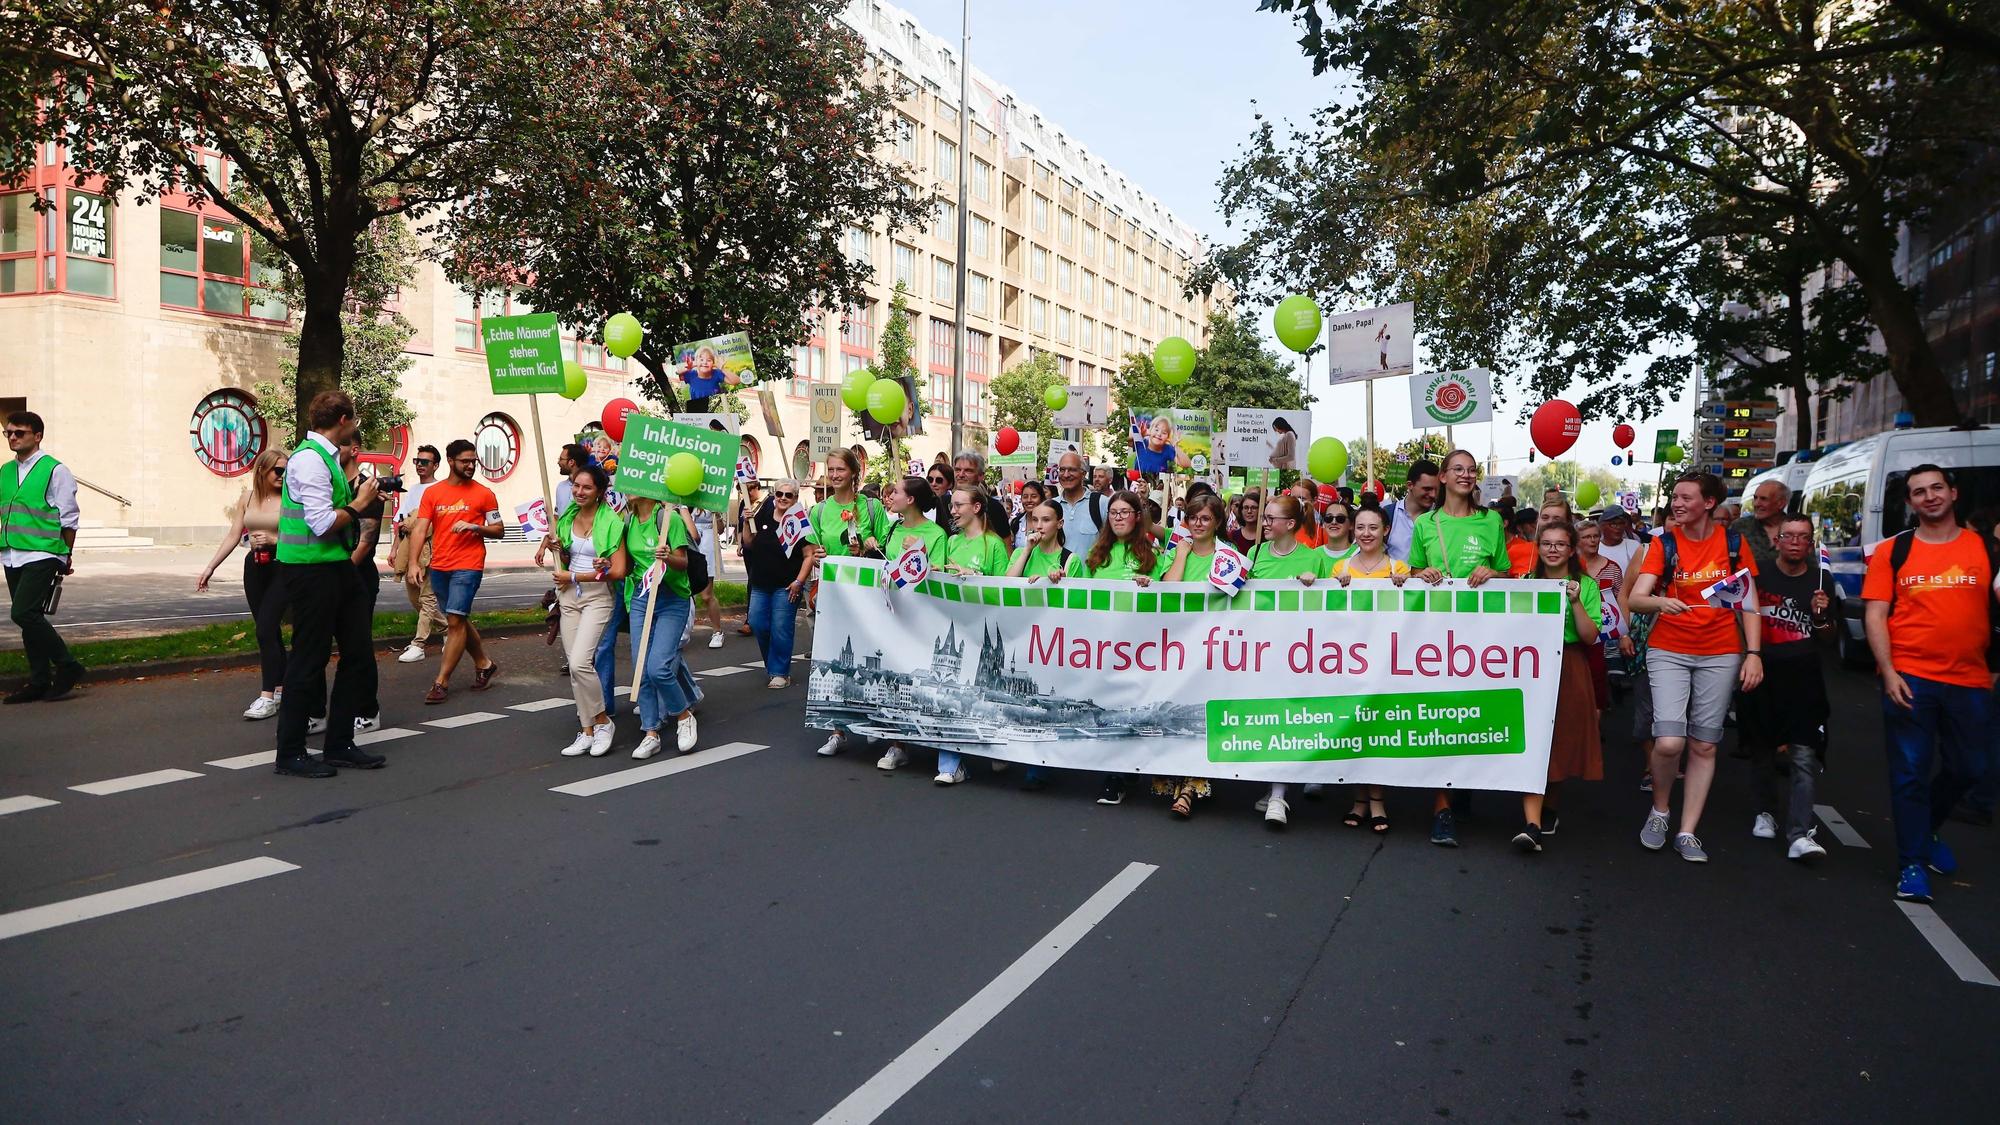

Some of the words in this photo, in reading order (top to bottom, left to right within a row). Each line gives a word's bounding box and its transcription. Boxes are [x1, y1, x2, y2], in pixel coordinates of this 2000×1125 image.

[73, 196, 105, 227] 24
[73, 224, 105, 240] HOURS
[73, 237, 105, 255] OPEN
[1333, 322, 1354, 331] Danke,
[1356, 317, 1374, 328] Papa!
[486, 327, 514, 344] „Echte
[722, 338, 732, 346] Ich
[509, 344, 538, 358] stehen
[496, 367, 507, 377] zu
[509, 363, 535, 377] ihrem
[537, 361, 558, 375] Kind
[815, 388, 837, 396] MUTTI
[1426, 374, 1446, 401] DANKE
[1451, 373, 1477, 398] MAMA!
[1734, 409, 1750, 417] 140
[813, 426, 824, 434] ICH
[826, 426, 839, 434] HAB
[1733, 429, 1749, 437] 127
[643, 424, 721, 456] Inklusion
[817, 436, 832, 444] DICH
[622, 466, 646, 479] vor
[649, 468, 668, 484] de
[701, 458, 727, 477] hon
[1672, 571, 1689, 580] IFE
[1692, 571, 1702, 579] IS
[1706, 570, 1727, 578] LIFE
[1900, 576, 1925, 586] LIFE
[1930, 576, 1943, 584] IS
[1948, 576, 1977, 585] LIFE
[1028, 624, 1185, 671] Marsch
[1203, 626, 1271, 672] für
[1288, 628, 1369, 674] das
[1391, 630, 1540, 679] Leben
[1221, 710, 1240, 727] Ja
[1244, 713, 1280, 726] zum
[1285, 707, 1334, 725] Leben
[1354, 705, 1379, 722] für
[1385, 704, 1412, 721] ein
[1417, 703, 1481, 724] Europa
[1221, 734, 1263, 751] ohne
[1267, 733, 1363, 753] Abtreibung
[1368, 729, 1402, 748] und
[1408, 726, 1510, 747] Euthanasie!
